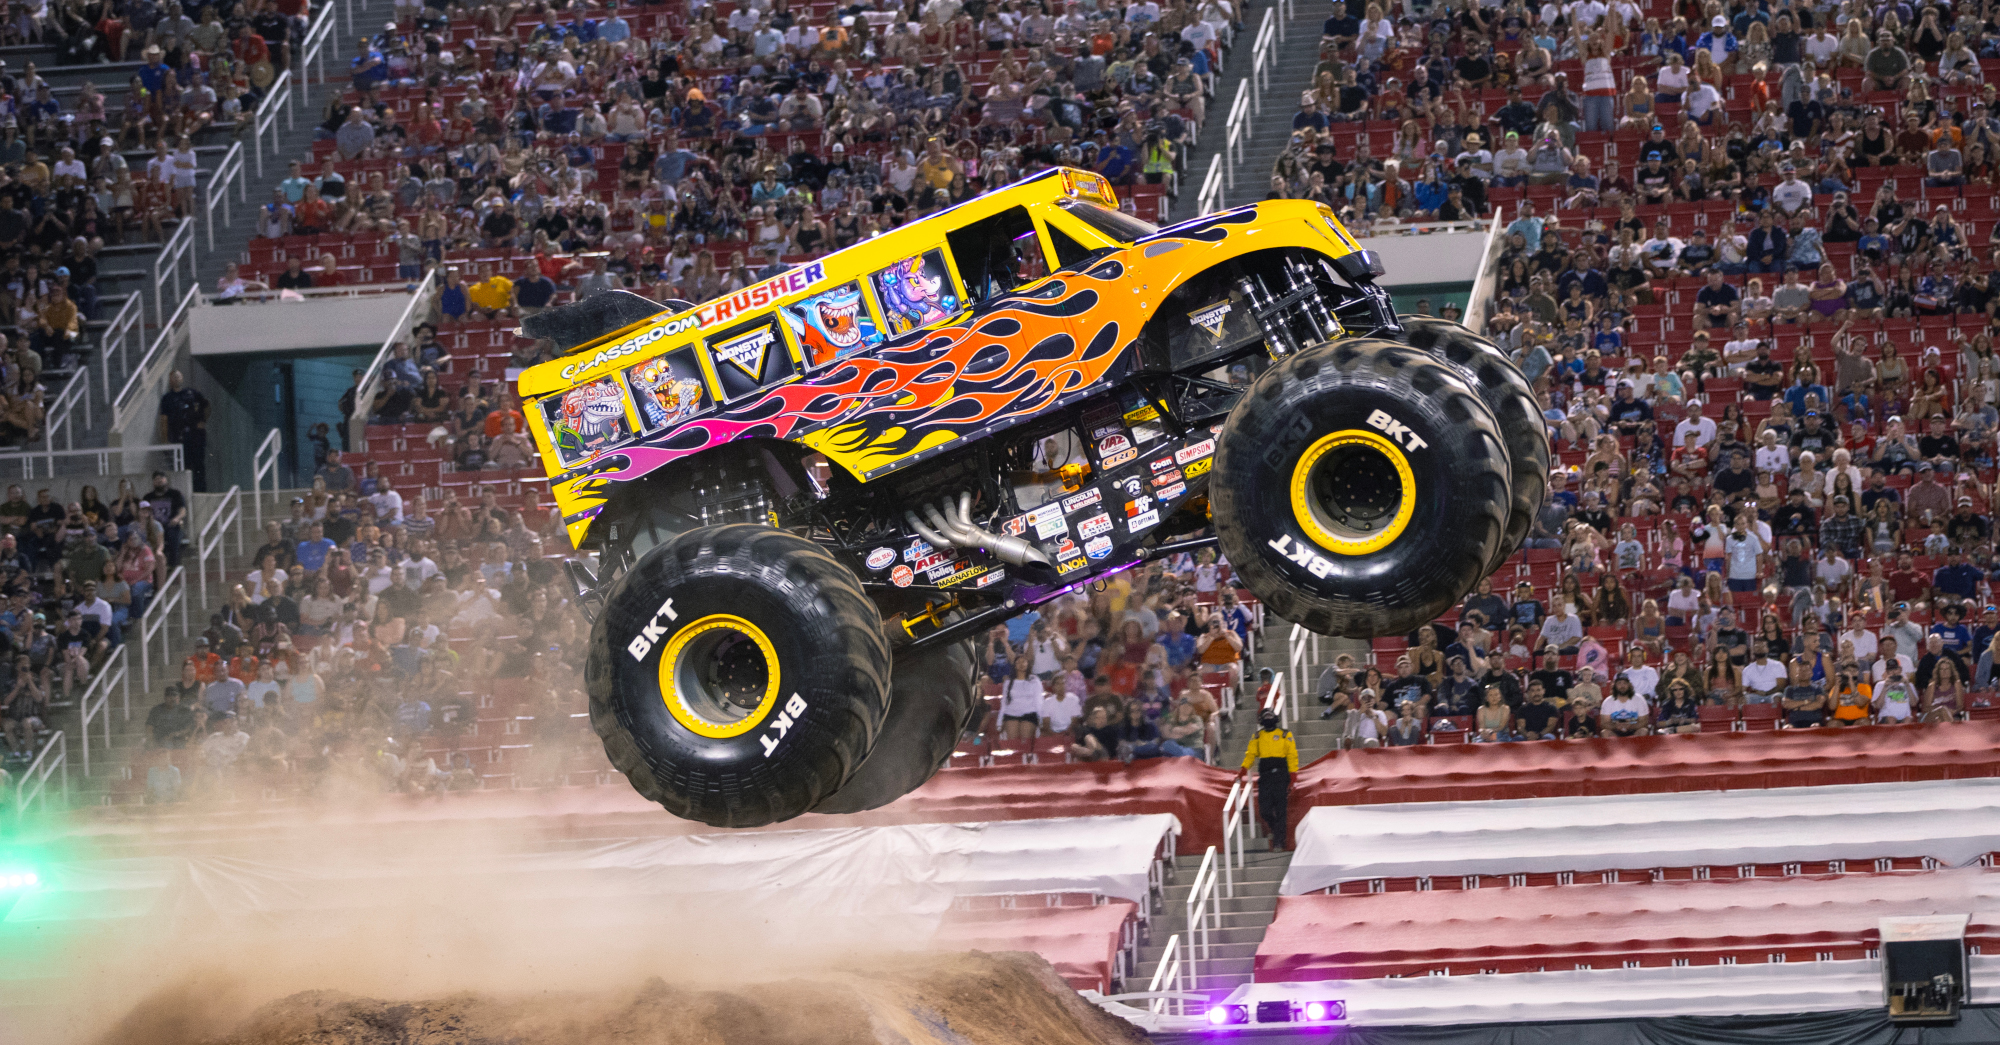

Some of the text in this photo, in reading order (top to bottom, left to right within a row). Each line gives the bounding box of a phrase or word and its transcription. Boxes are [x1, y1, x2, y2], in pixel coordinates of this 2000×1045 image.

[560, 262, 826, 379] CLASSROOM CRUSHER
[1190, 305, 1232, 325] MONSTER
[1204, 315, 1223, 327] JAM
[716, 332, 775, 363] MONSTER
[736, 349, 763, 365] JAM
[1364, 408, 1429, 453] BKT
[1101, 435, 1125, 451] JAZ
[1180, 442, 1211, 461] SIMPSON
[1150, 458, 1172, 471] Coan
[916, 547, 955, 571] ARP
[1056, 556, 1088, 574] UNOH
[1268, 533, 1334, 580] BKT
[928, 565, 955, 581] Holley
[938, 565, 987, 588] MAGNAFLOW
[627, 598, 678, 662] BKT
[759, 692, 807, 758] BKT
